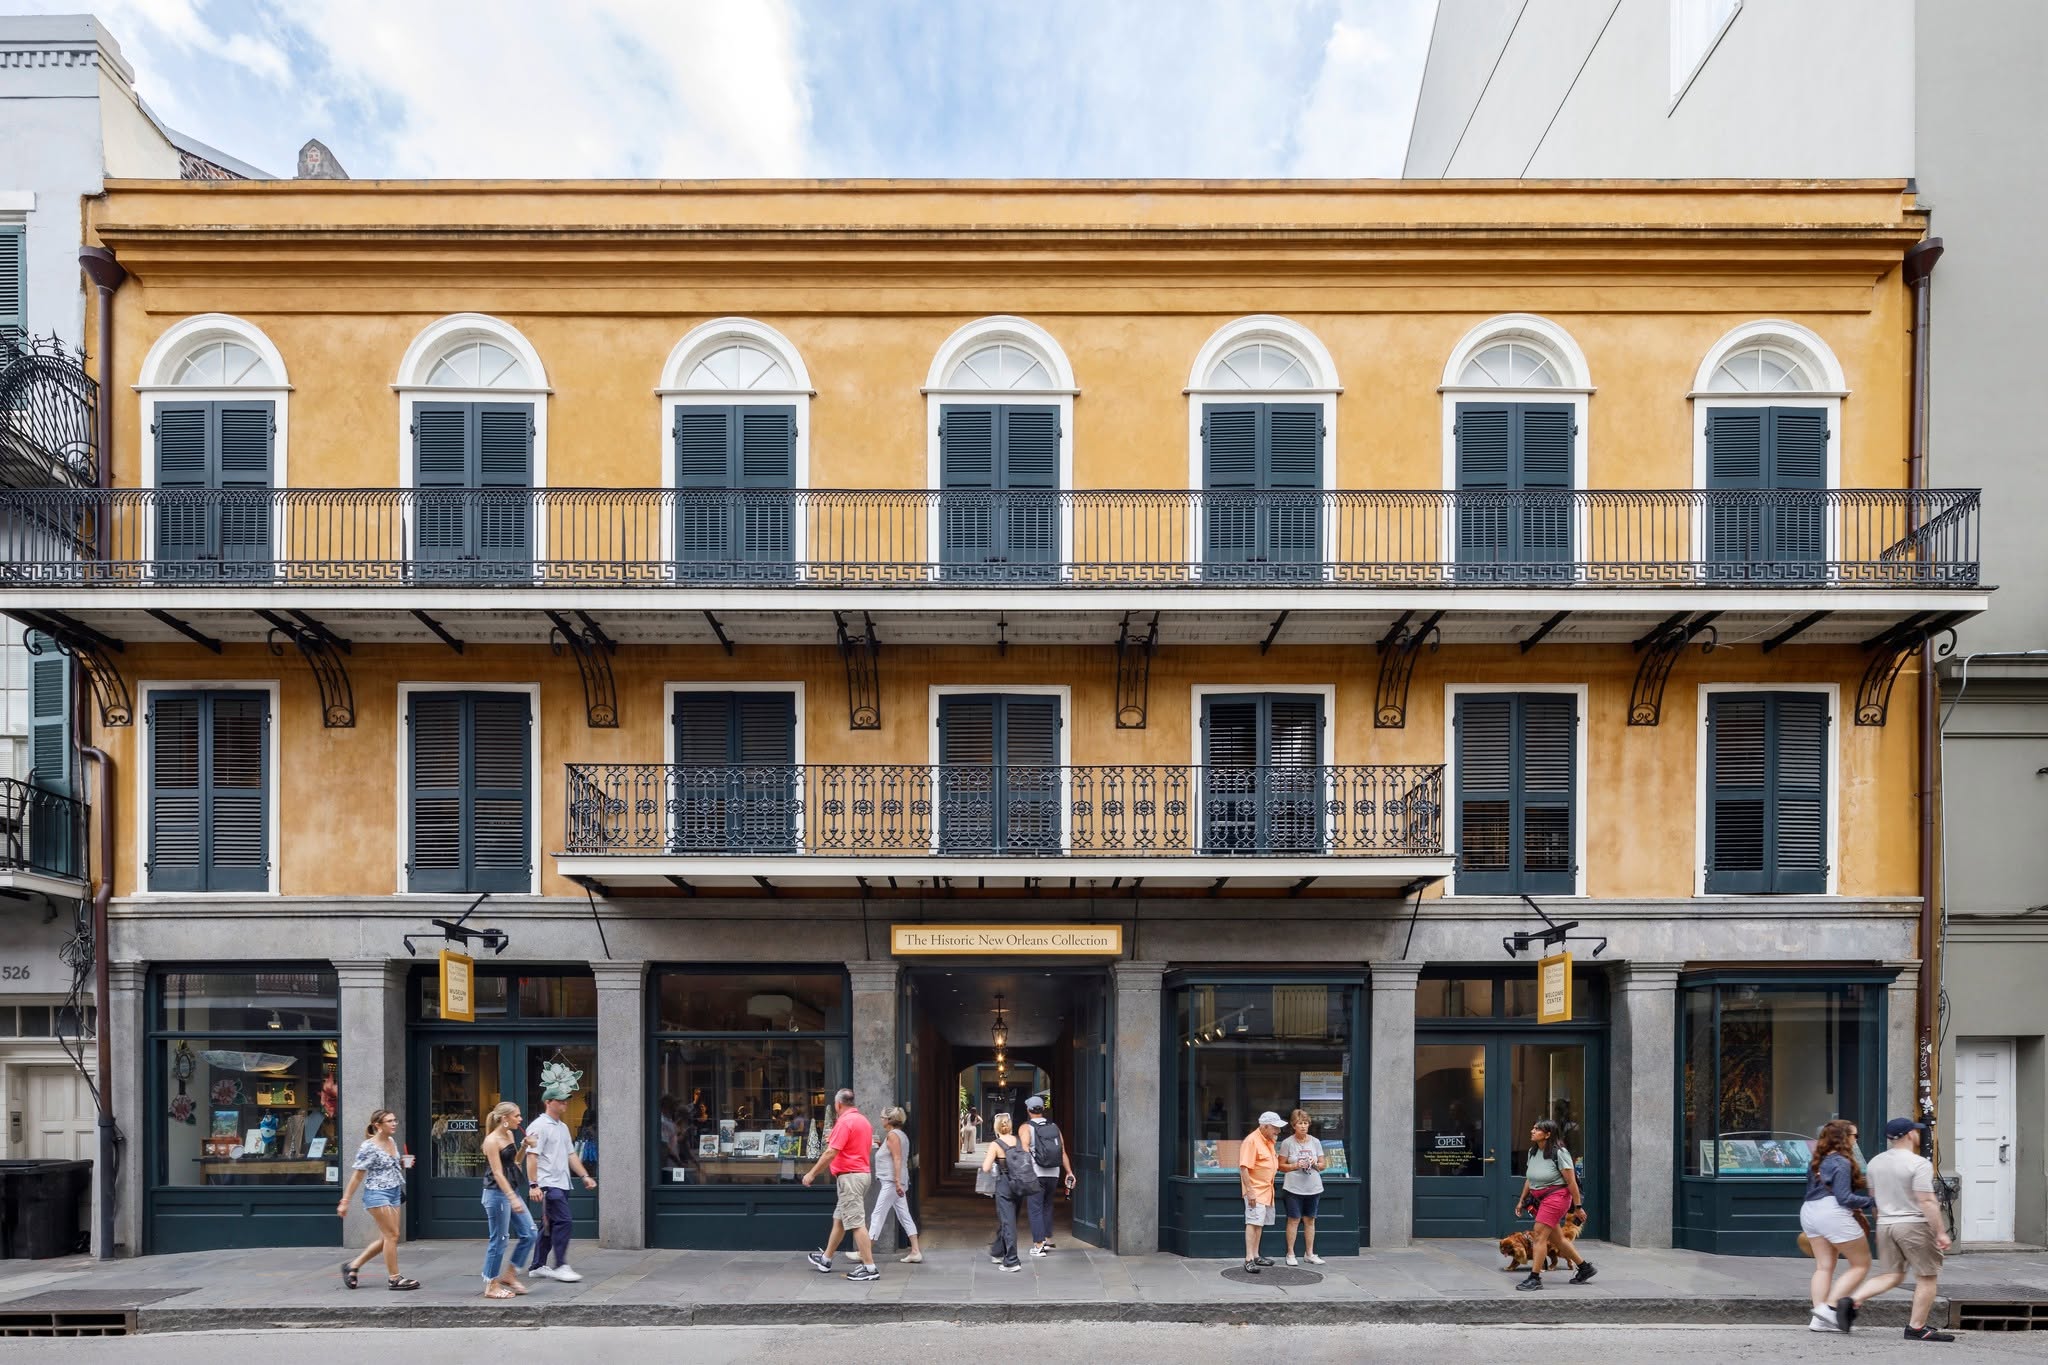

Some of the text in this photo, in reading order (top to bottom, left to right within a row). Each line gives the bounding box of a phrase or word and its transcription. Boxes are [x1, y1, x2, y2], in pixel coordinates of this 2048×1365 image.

[904, 933, 1108, 946] The Historic New Orleans Collection
[2, 965, 30, 980] 526
[450, 1121, 476, 1130] OPEN
[1437, 1138, 1464, 1146] OPEN
